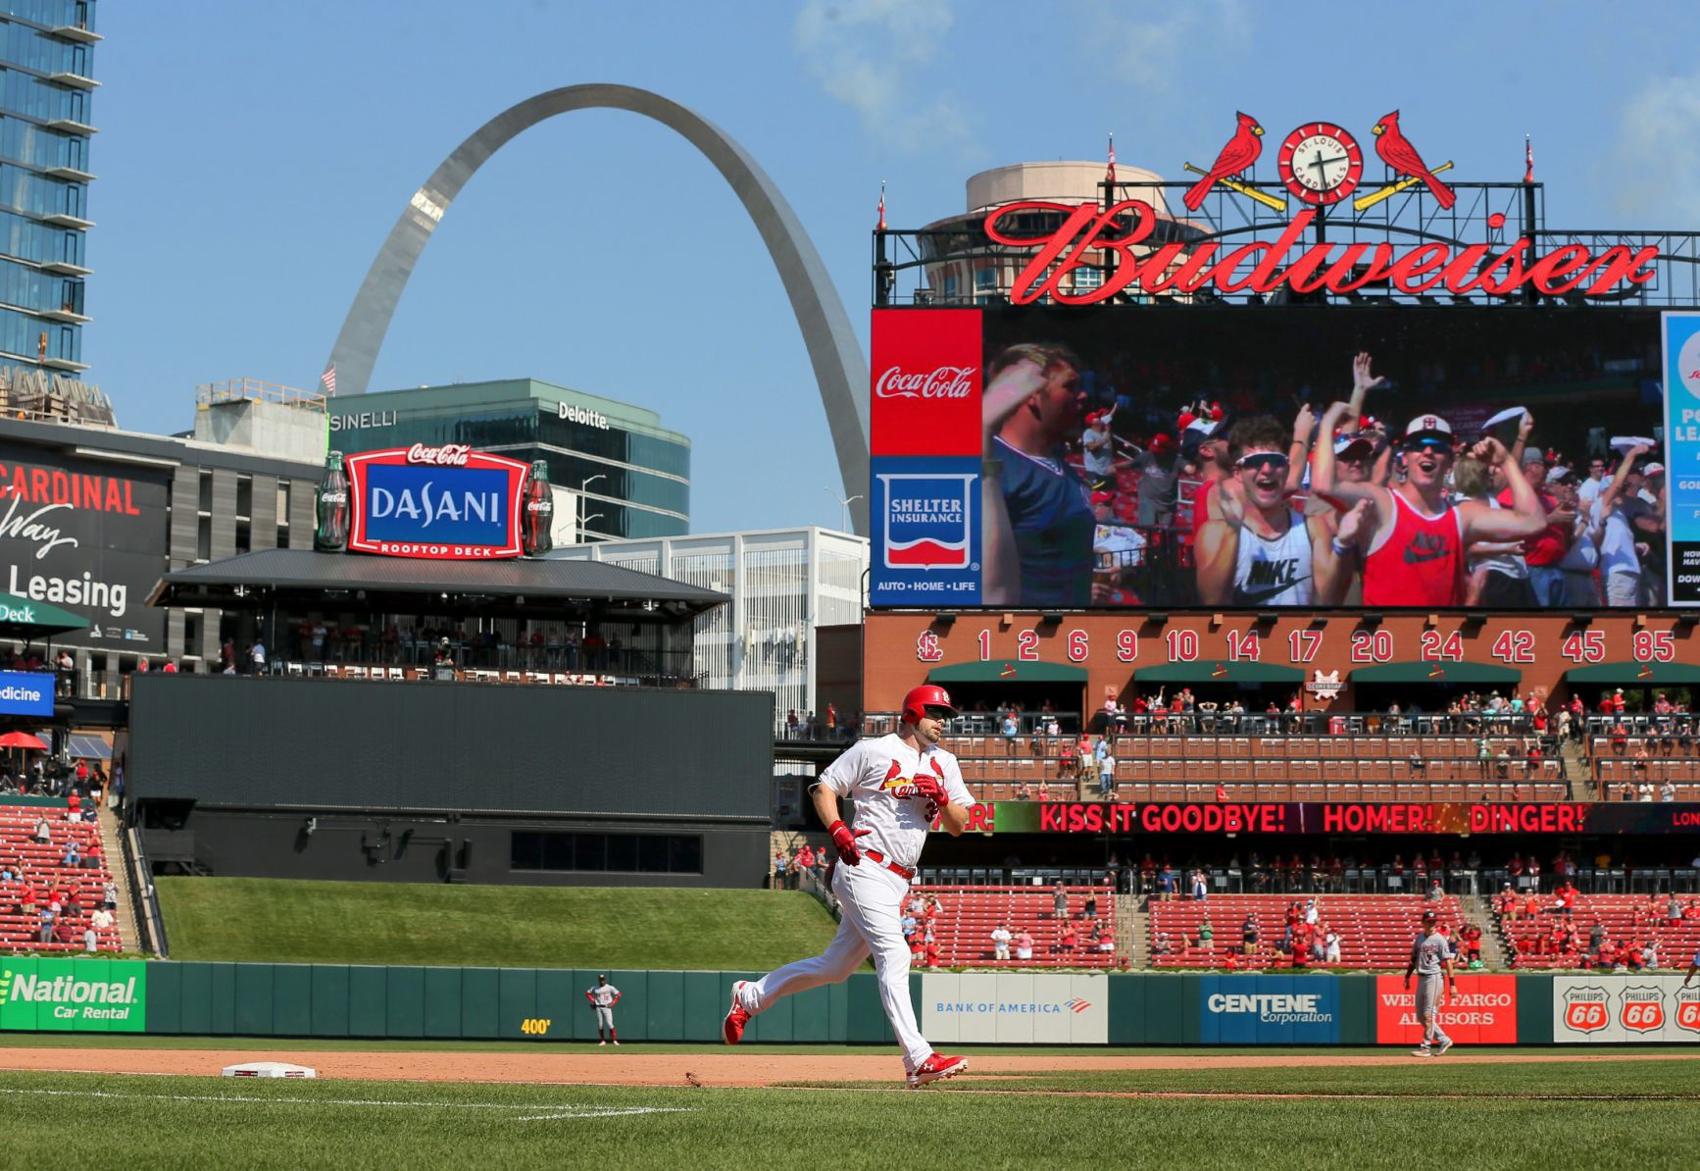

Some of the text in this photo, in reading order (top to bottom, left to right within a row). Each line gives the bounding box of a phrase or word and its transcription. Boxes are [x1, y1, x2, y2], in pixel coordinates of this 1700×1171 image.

[1314, 137, 1344, 154] LOUIS
[985, 200, 1661, 306] Budweiser
[876, 366, 977, 399] Coca-Cola
[406, 443, 471, 465] Coca-Cola
[0, 463, 142, 516] CARDINAL
[371, 481, 501, 528] DASANI
[891, 499, 963, 513] SHELTER
[891, 513, 963, 523] INSURANCE
[381, 543, 492, 557] ROOFTOP DECK
[1248, 558, 1299, 585] NIKE
[9, 564, 127, 617] Leasing
[877, 582, 976, 592] AUTO HOME LIFE
[979, 629, 990, 662] 1
[1018, 629, 1039, 662] 2
[1068, 629, 1089, 662] 6
[1116, 629, 1138, 662] 9
[1168, 629, 1199, 662] 10
[1227, 629, 1261, 662] 14
[1289, 629, 1323, 662] 17
[1351, 630, 1393, 662] 20
[1421, 630, 1464, 663] 24
[1492, 630, 1536, 663] 42
[1561, 630, 1606, 663] 45
[1633, 630, 1675, 663] 85
[0, 686, 41, 702] dicine
[1040, 804, 1101, 832] KISS
[1110, 804, 1135, 832] IT
[1142, 804, 1285, 832] GOODBYE!
[1323, 804, 1433, 832] HOMER!
[1471, 804, 1584, 832] DINGER!
[10, 973, 136, 1004] National
[1570, 992, 1603, 1001] PHILLIPS
[1625, 992, 1659, 1001] PHILLIPS
[936, 1003, 1061, 1014] BANK OF AMERICA
[1207, 994, 1317, 1014] CENTENE
[1452, 993, 1511, 1006] FARGO
[54, 1006, 129, 1020] Car Rental
[1260, 1011, 1332, 1025] Corporation
[1571, 1005, 1601, 1024] 66
[1627, 1005, 1657, 1024] 66
[1682, 1005, 1700, 1024] 6
